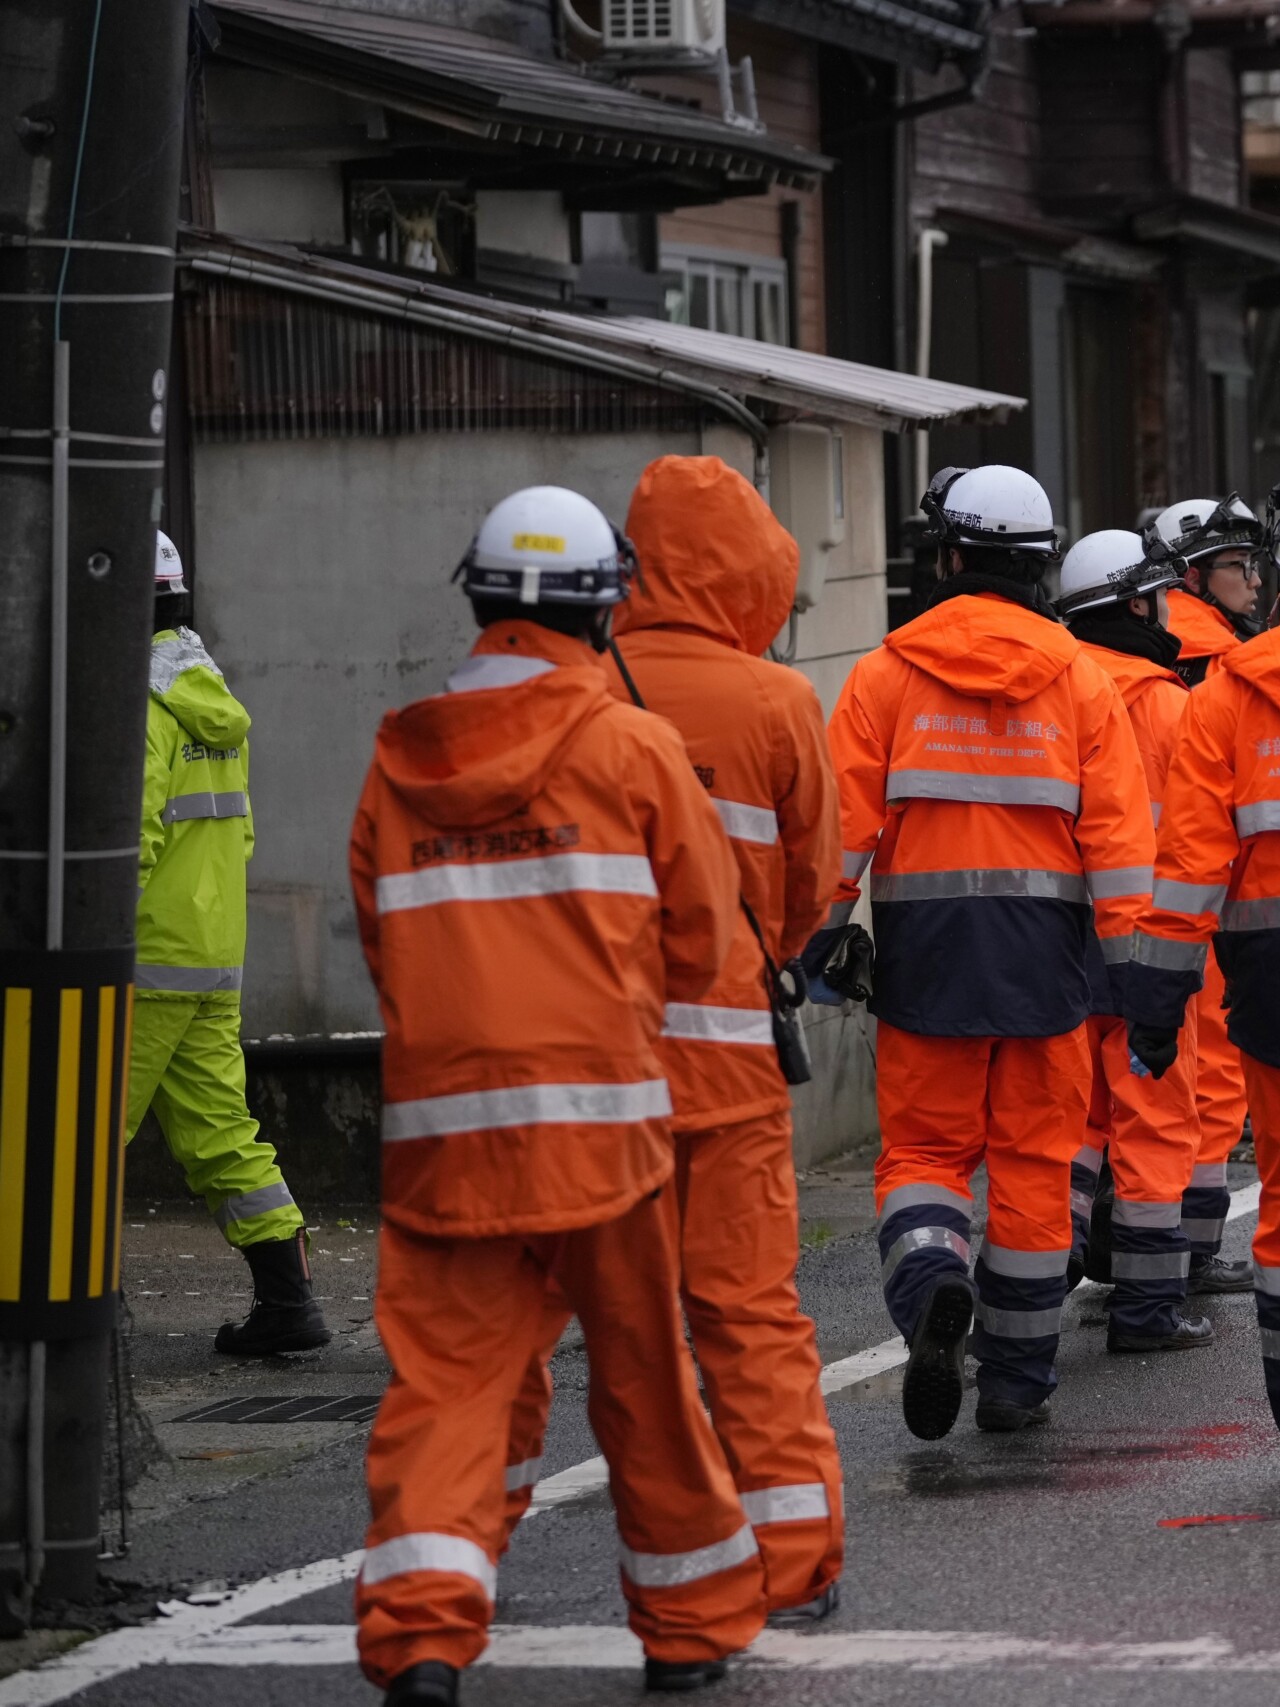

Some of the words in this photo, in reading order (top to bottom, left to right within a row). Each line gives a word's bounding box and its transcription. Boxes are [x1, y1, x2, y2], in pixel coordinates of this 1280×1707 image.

[913, 713, 1061, 742] 海部南部防組合
[924, 742, 986, 755] AMANANBU
[989, 747, 1014, 757] FIRE
[1017, 748, 1048, 759] DEPT.
